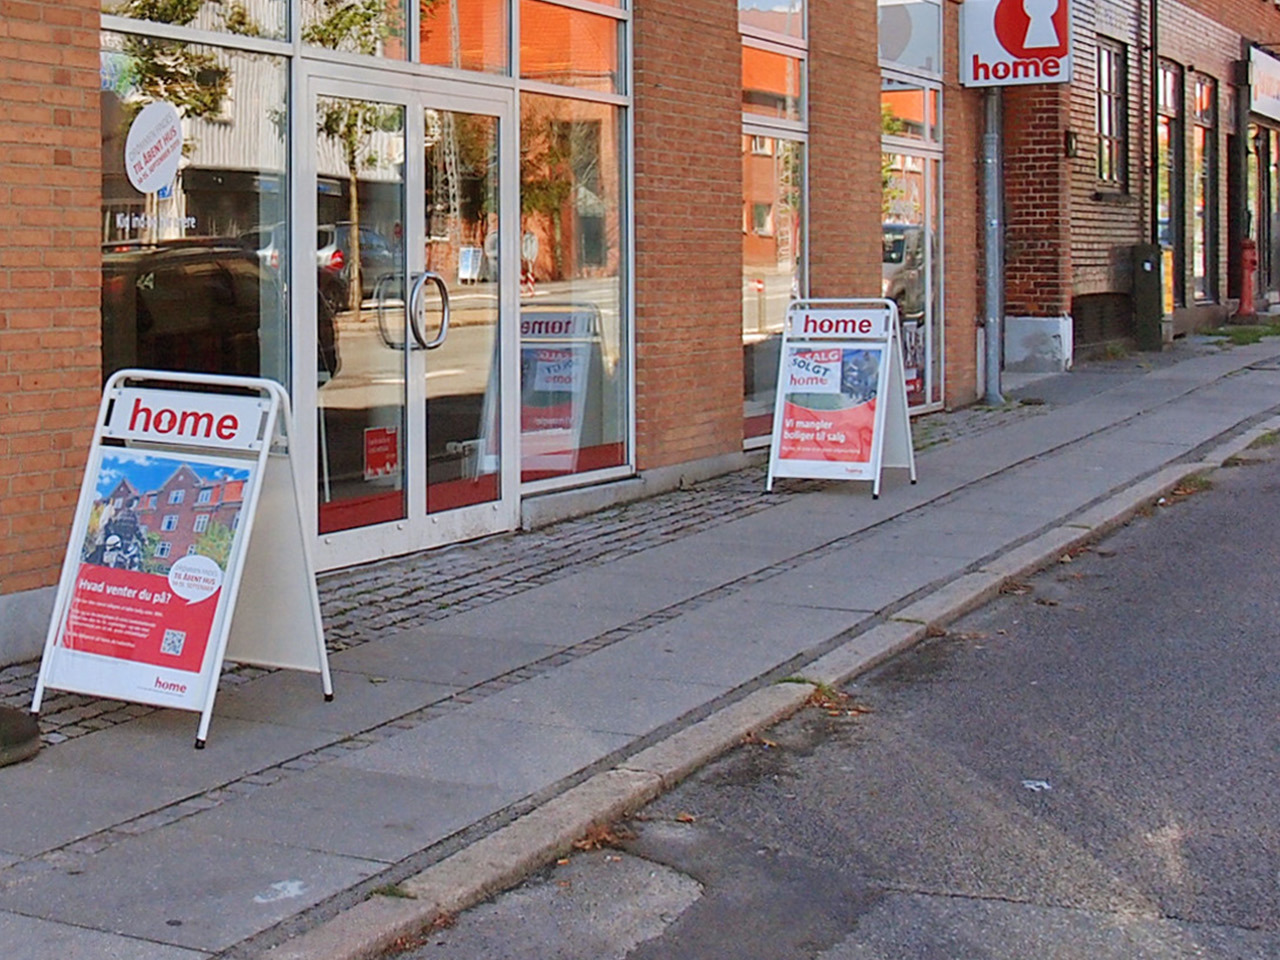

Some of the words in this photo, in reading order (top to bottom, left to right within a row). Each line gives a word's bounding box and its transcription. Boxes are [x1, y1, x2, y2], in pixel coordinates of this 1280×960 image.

[972, 54, 1060, 81] home
[803, 315, 872, 333] home
[792, 358, 831, 377] SOLGT
[790, 373, 829, 386] home
[128, 398, 239, 440] home
[785, 418, 794, 427] Vi
[795, 419, 833, 430] mangler
[783, 430, 814, 442] boliger
[816, 431, 826, 441] til
[827, 432, 846, 443] salg
[78, 578, 105, 594] Hvad
[106, 585, 138, 599] venter
[138, 588, 152, 601] du
[152, 591, 172, 605] på?
[154, 676, 187, 694] home
